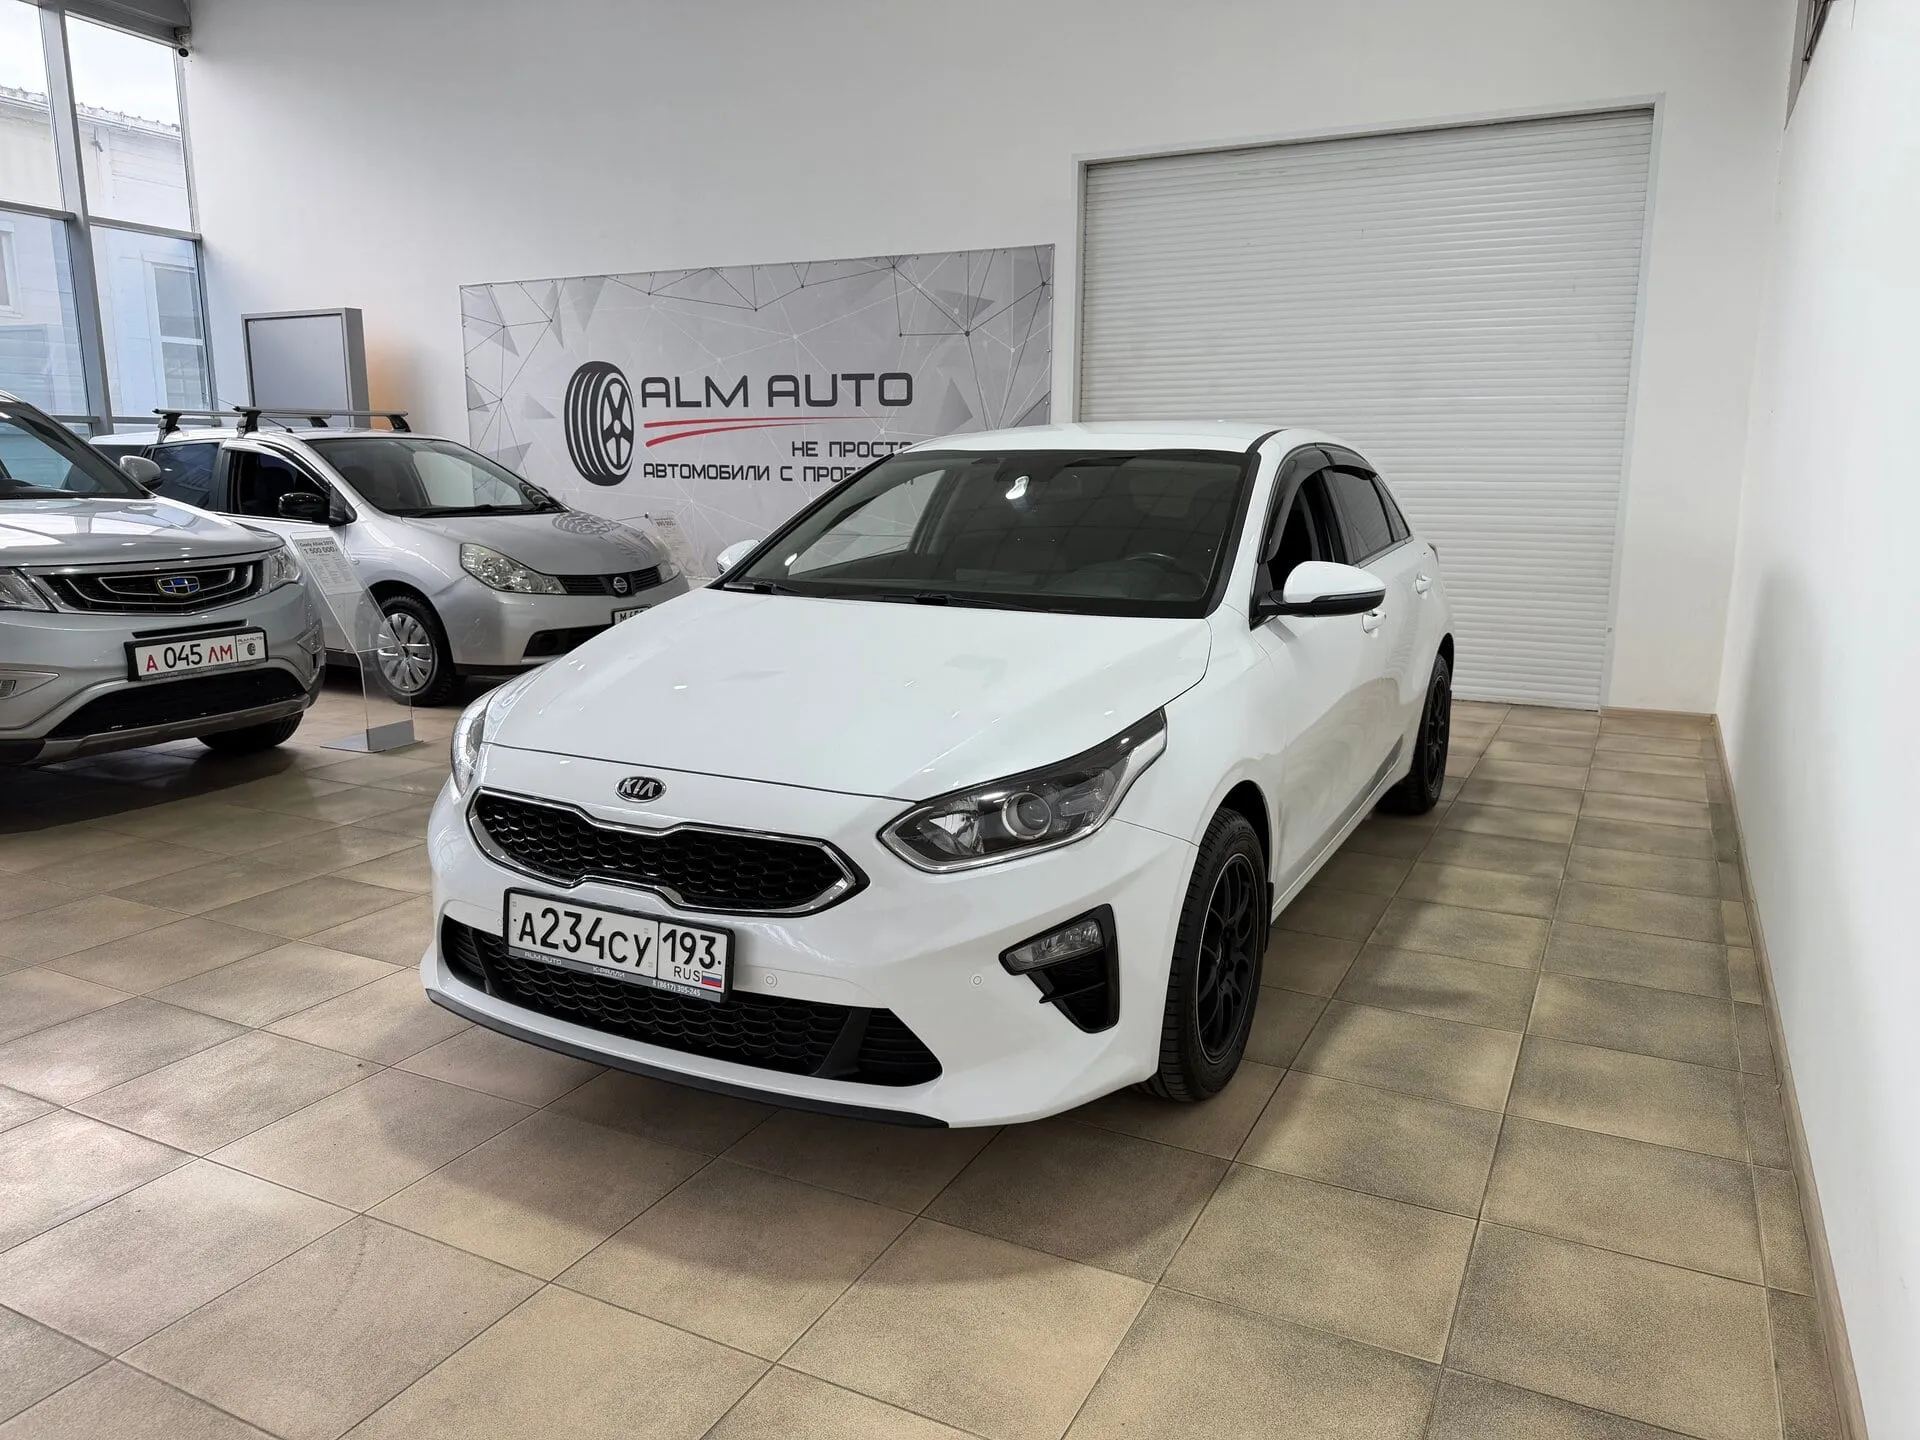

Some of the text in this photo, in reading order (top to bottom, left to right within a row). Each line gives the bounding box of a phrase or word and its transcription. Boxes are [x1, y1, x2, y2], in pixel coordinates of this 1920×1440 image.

[641, 372, 913, 408] ALM AUTO
[792, 441, 818, 457] НЕ
[644, 463, 770, 481] АВТОМОБИЛИ
[780, 466, 793, 481] С
[163, 643, 203, 669] 045
[620, 778, 656, 797] KIA
[662, 928, 717, 970] 193
[673, 965, 700, 982] RUS
